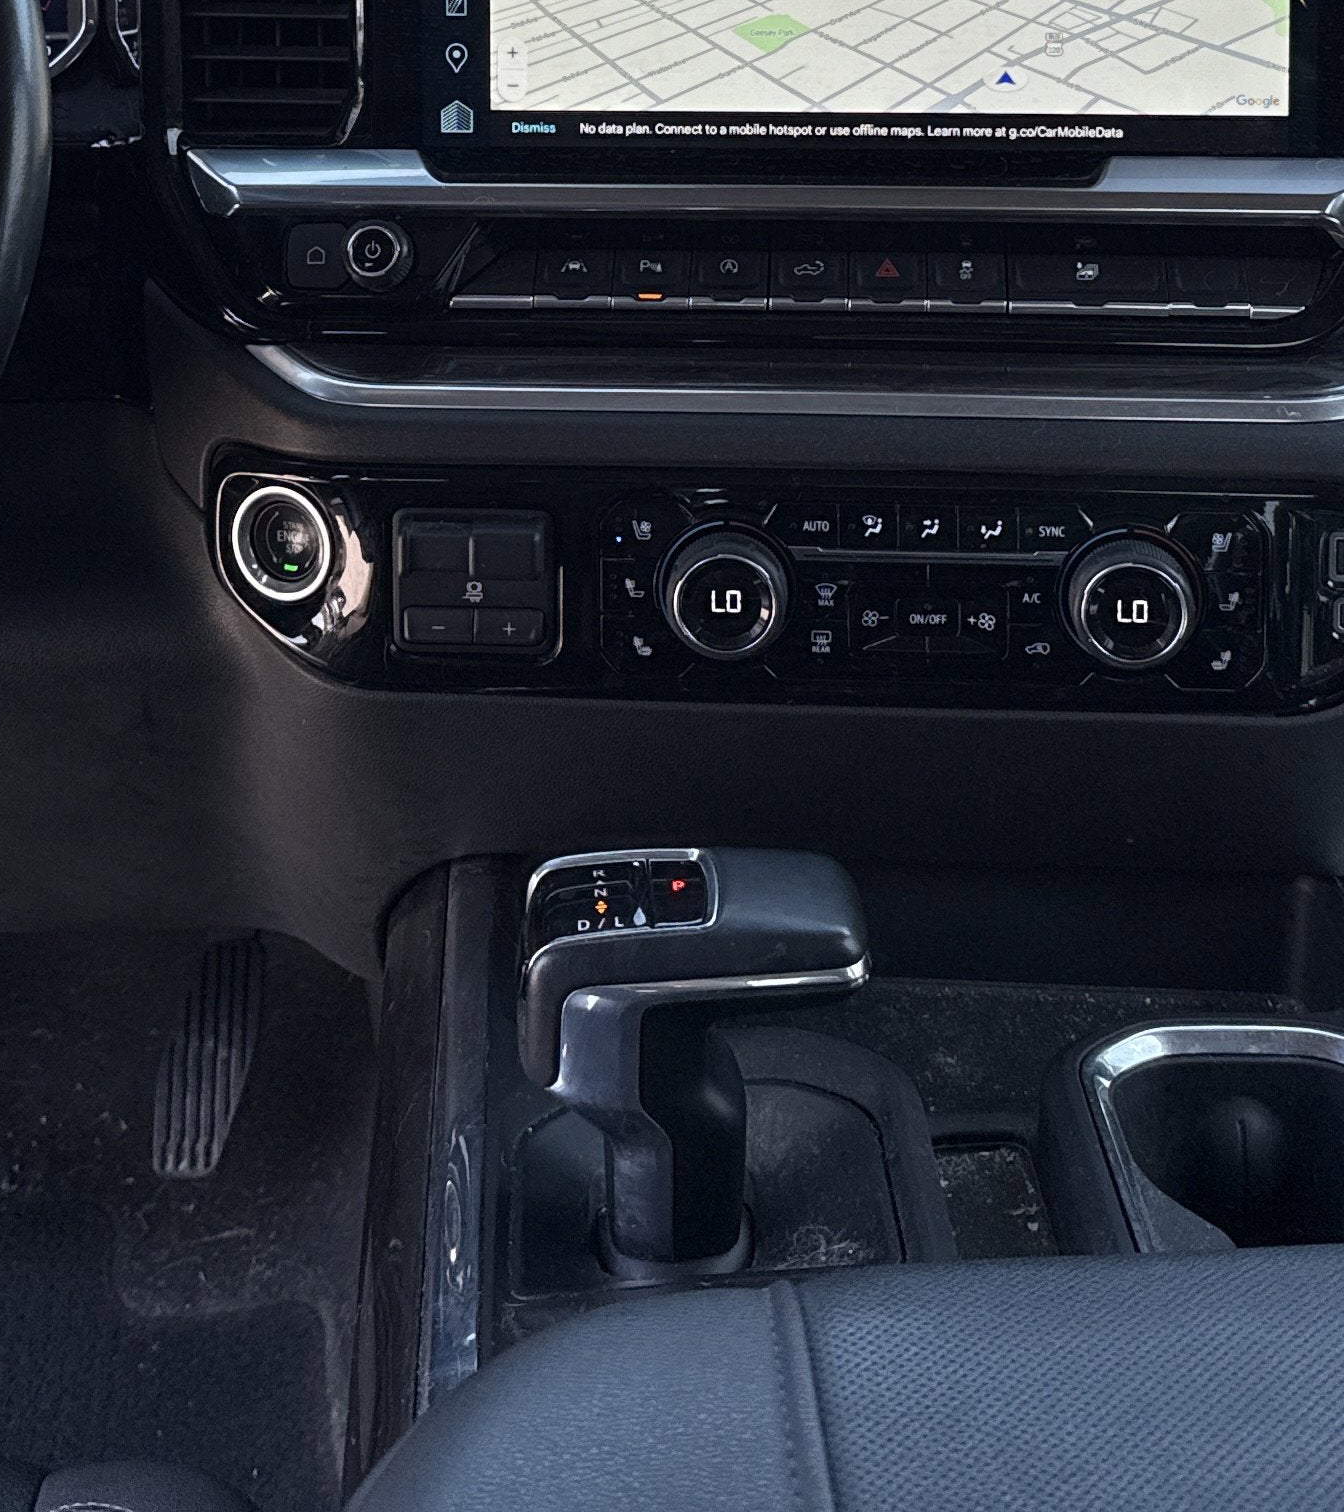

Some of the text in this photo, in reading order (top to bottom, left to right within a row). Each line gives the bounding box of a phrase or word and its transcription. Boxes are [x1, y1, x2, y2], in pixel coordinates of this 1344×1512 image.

[1234, 93, 1281, 109] Google
[511, 121, 557, 134] Dismiss
[579, 122, 1124, 141] No data plan. Connect to a mobile hotspot or use offline maps. Learn more at g.co/CarMobileData
[802, 520, 831, 533] AUTO
[1038, 525, 1066, 538] SYNC
[817, 598, 835, 607] MAX
[1022, 592, 1042, 605] A/C
[909, 613, 948, 626] ON/OFF
[671, 879, 686, 892] P
[594, 887, 609, 899] N
[577, 918, 591, 932] D
[614, 915, 625, 928] L
